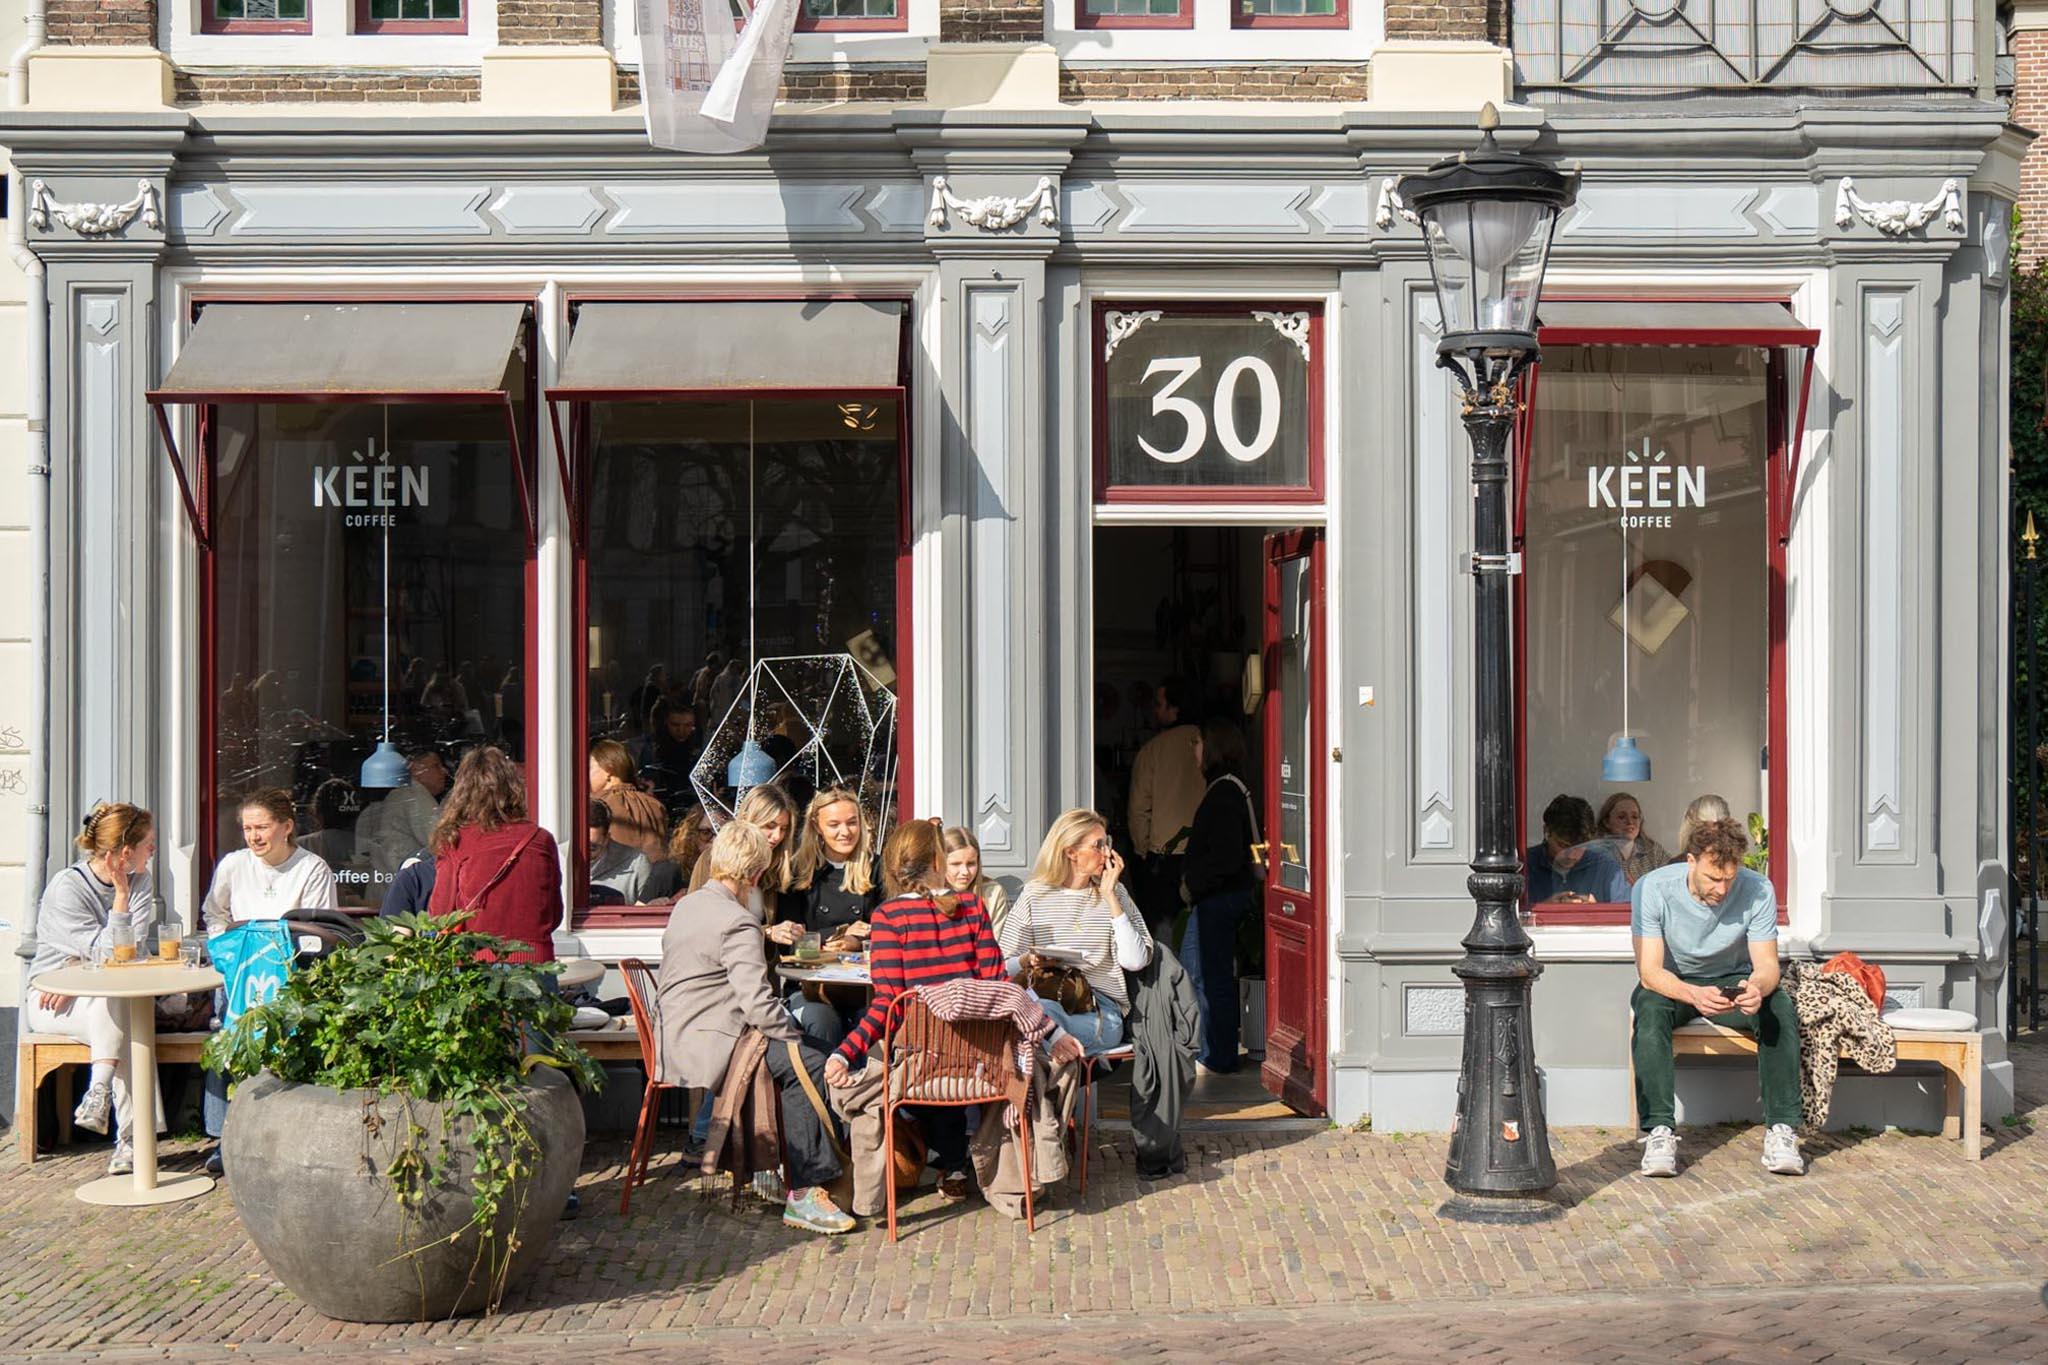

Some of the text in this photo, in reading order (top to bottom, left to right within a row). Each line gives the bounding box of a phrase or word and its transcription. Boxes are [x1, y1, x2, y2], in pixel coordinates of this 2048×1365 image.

[1137, 356, 1281, 463] 30
[314, 466, 429, 507] KEEN
[1588, 466, 1706, 508] KEEN
[345, 515, 397, 527] COFFEE
[1620, 516, 1672, 528] COFFEE
[331, 870, 398, 884] offee ba
